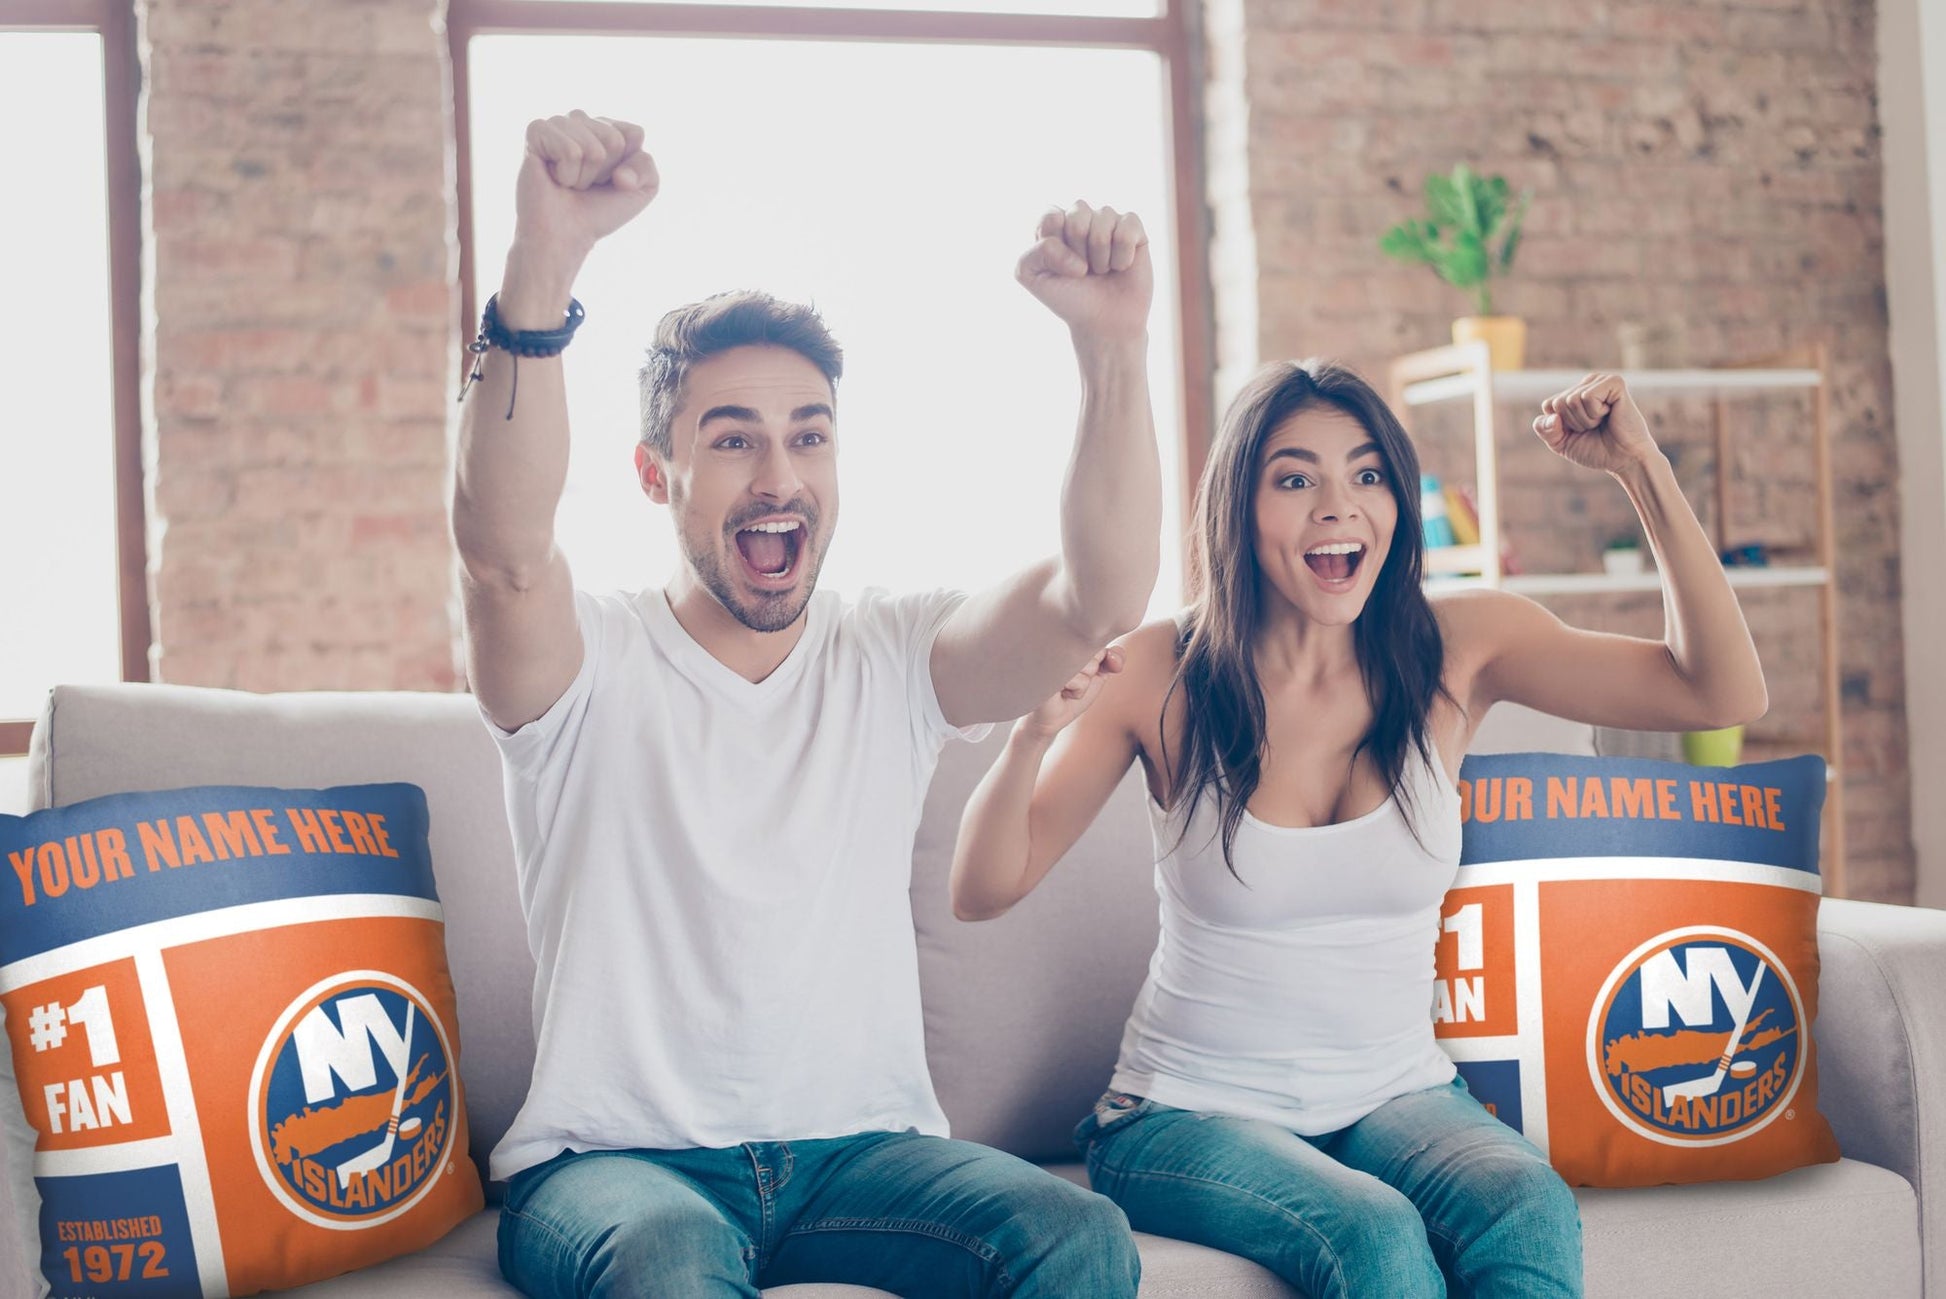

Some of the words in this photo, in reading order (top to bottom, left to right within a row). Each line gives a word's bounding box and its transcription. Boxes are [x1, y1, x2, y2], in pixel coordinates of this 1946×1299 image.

[1547, 776, 1681, 820] NAME
[1689, 780, 1786, 831] HERE
[8, 828, 136, 907] YOUR
[136, 808, 290, 872] NAME
[286, 808, 400, 859] HERE
[1438, 903, 1484, 971] 1
[28, 985, 121, 1068] #1
[1430, 976, 1486, 1023] AN
[43, 1071, 133, 1134] FAN
[1620, 1051, 1787, 1129] ISLANDERS
[291, 1099, 445, 1208] ISLANDERS
[57, 1215, 162, 1242] ESTABLISHED
[63, 1240, 169, 1283] 1972
